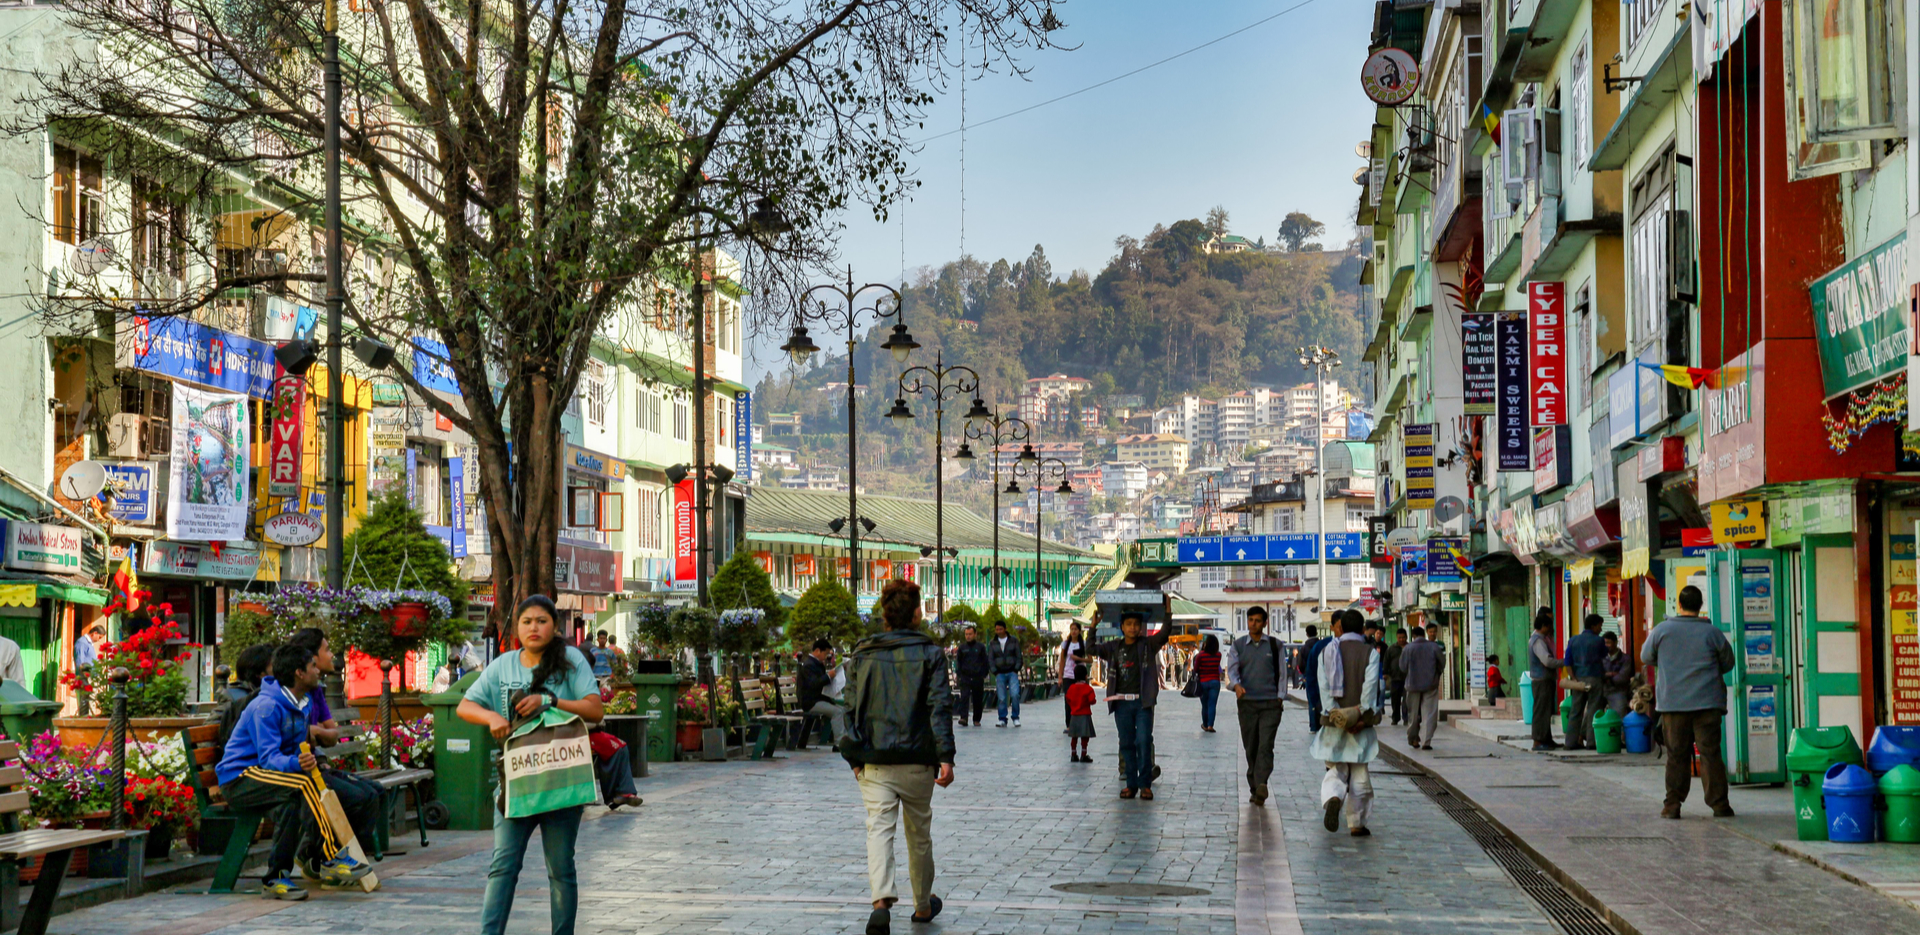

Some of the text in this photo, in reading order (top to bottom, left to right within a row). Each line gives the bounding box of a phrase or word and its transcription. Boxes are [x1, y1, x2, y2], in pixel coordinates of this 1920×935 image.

[1365, 71, 1416, 101] KARAOKE
[1826, 270, 1863, 338] GUPTA
[1876, 240, 1907, 312] HOUS
[1535, 283, 1558, 356] CYBER
[1465, 332, 1494, 341] AIR TICK
[1465, 345, 1479, 353] RAIL
[224, 350, 249, 374] HDFC
[250, 359, 275, 381] BANK
[1467, 356, 1495, 364] DOMESTI
[1506, 325, 1521, 448] LAXMI SWEETS
[1536, 366, 1560, 424] CAFÉ
[1611, 380, 1633, 418] NOKIA
[1708, 381, 1747, 437] BHARAT
[275, 371, 296, 480] ARIVAR
[108, 472, 148, 490] TM
[272, 516, 318, 532] PARIVAR
[1723, 523, 1756, 538] spice
[39, 530, 59, 549] Medical
[60, 533, 78, 550] Stores
[276, 533, 310, 543] PURE VEG
[1374, 522, 1386, 555] BAG
[224, 554, 258, 566] RESTAURANT
[579, 561, 588, 573] AXIS
[589, 562, 601, 574] BANK
[1899, 646, 1920, 654] CAN
[1899, 668, 1920, 676] LUGG
[1897, 679, 1920, 687] UMB
[1900, 690, 1920, 699] TRO
[1895, 701, 1914, 709] HEALTH
[1898, 713, 1920, 721] RAIN
[511, 744, 584, 772] BAARCELONA
